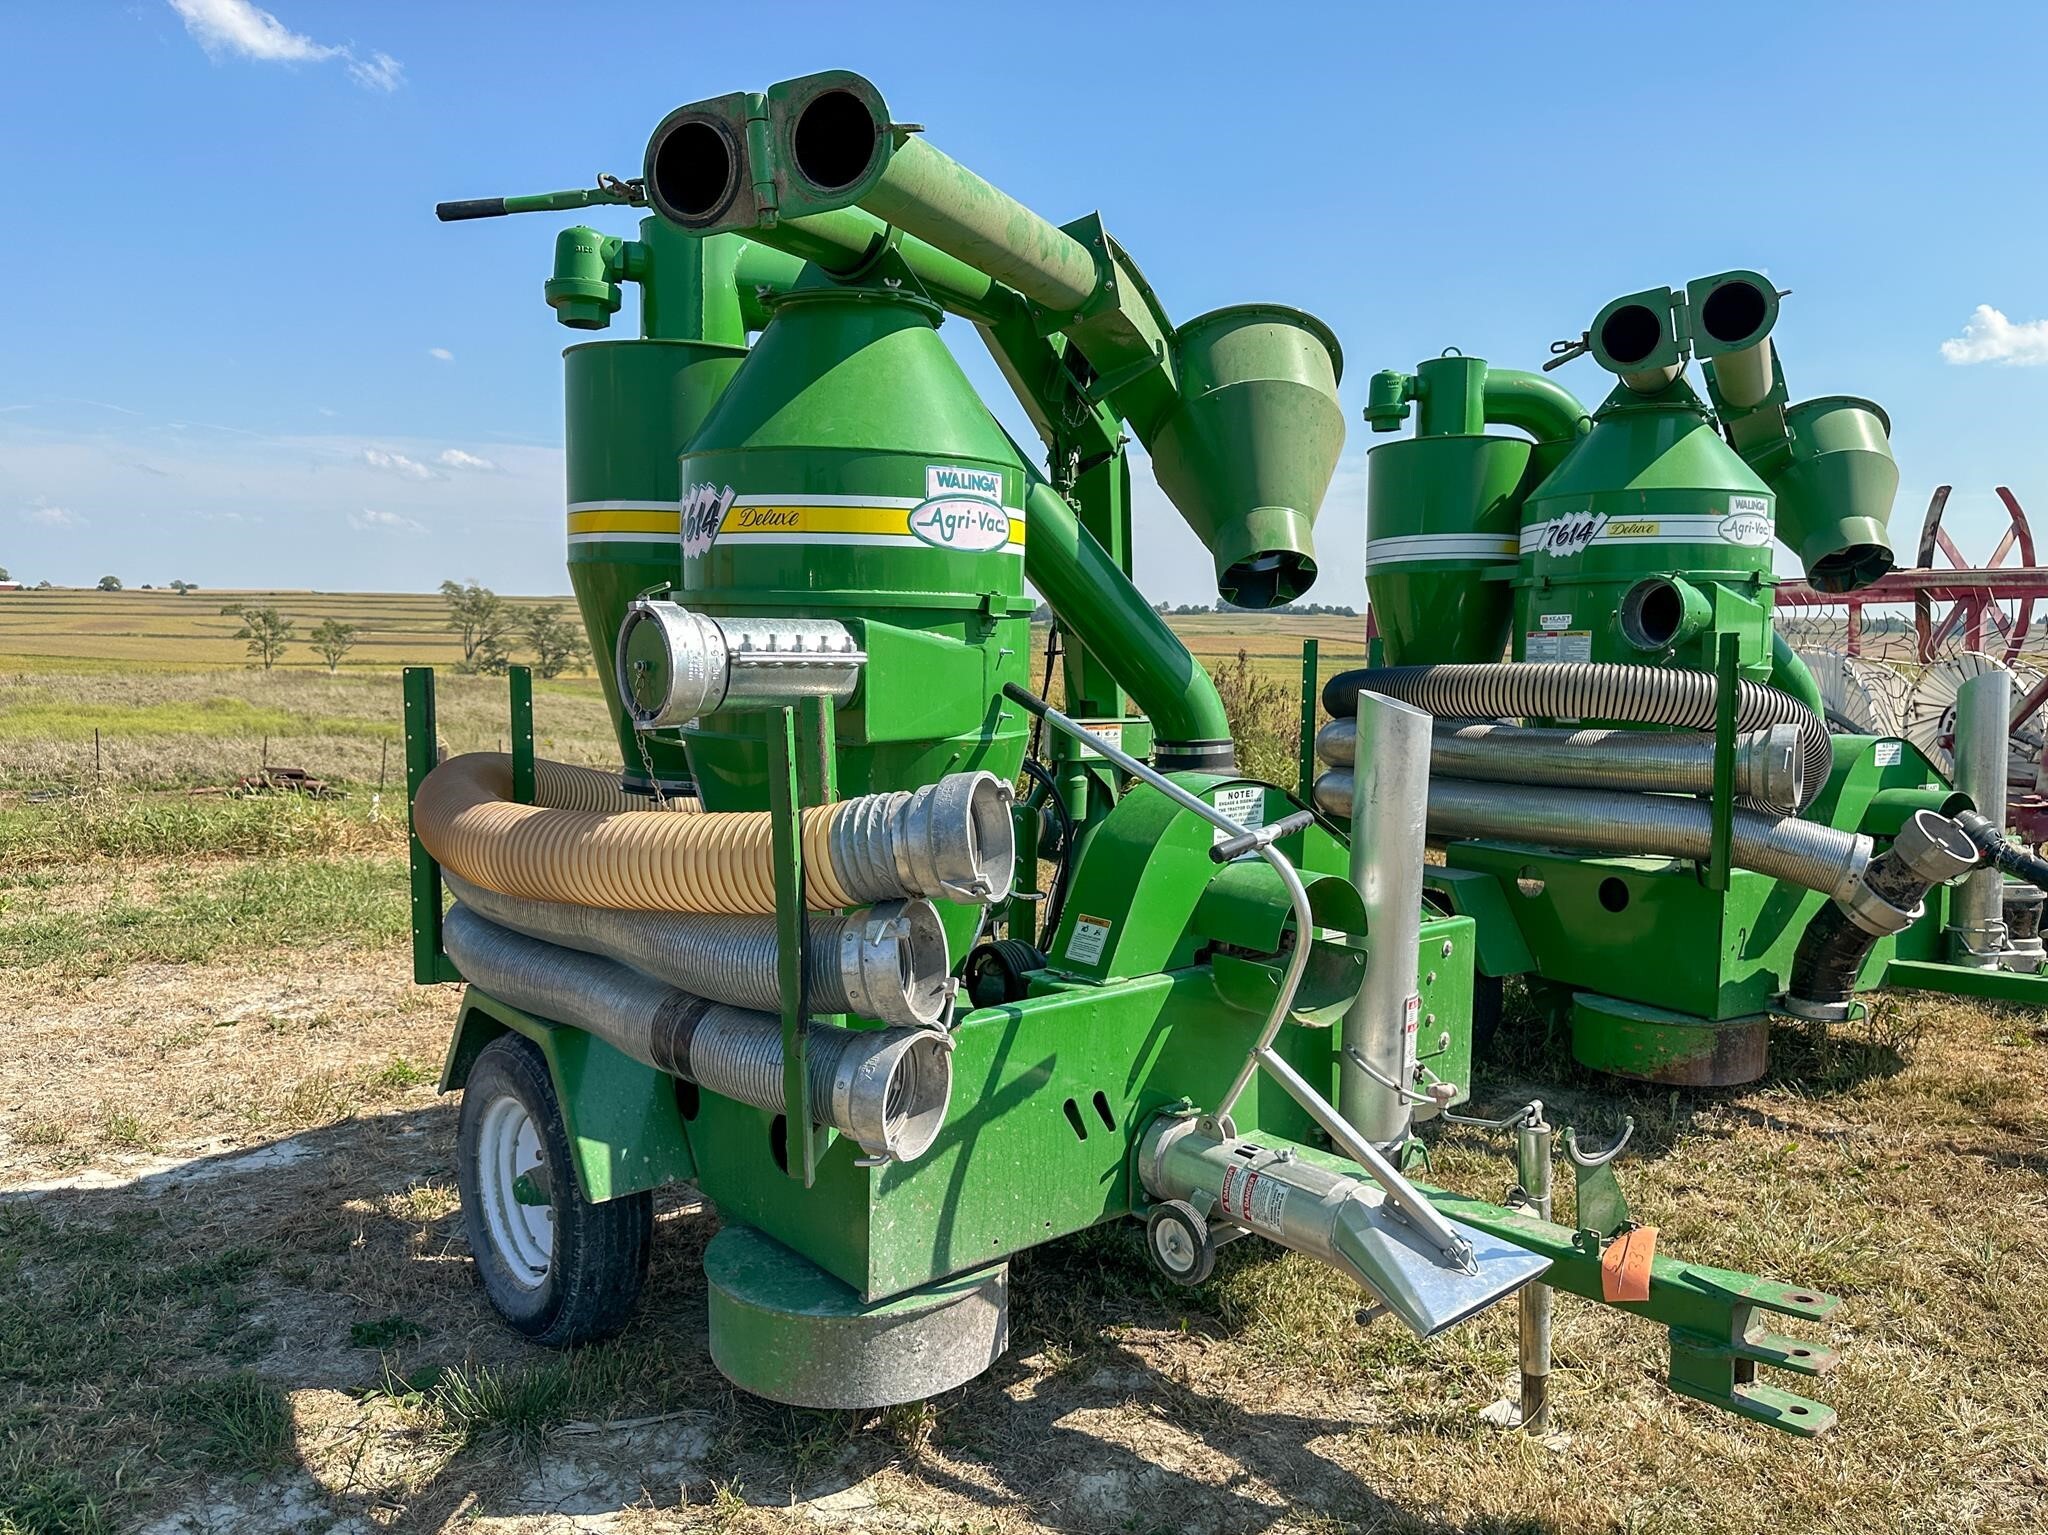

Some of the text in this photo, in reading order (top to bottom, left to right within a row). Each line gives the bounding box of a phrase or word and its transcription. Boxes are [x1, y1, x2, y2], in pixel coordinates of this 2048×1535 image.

[936, 471, 997, 493] WALINGA
[1736, 499, 1766, 511] WALINGA
[738, 507, 800, 528] Deluxe
[917, 507, 1006, 541] Agri-Vac
[1547, 521, 1655, 549] 7614 Deluxe
[1723, 519, 1769, 541] Agri-Vac
[1228, 789, 1254, 800] NOTE!
[1223, 1167, 1235, 1199] DANGER
[1244, 1177, 1256, 1208] DANGER
